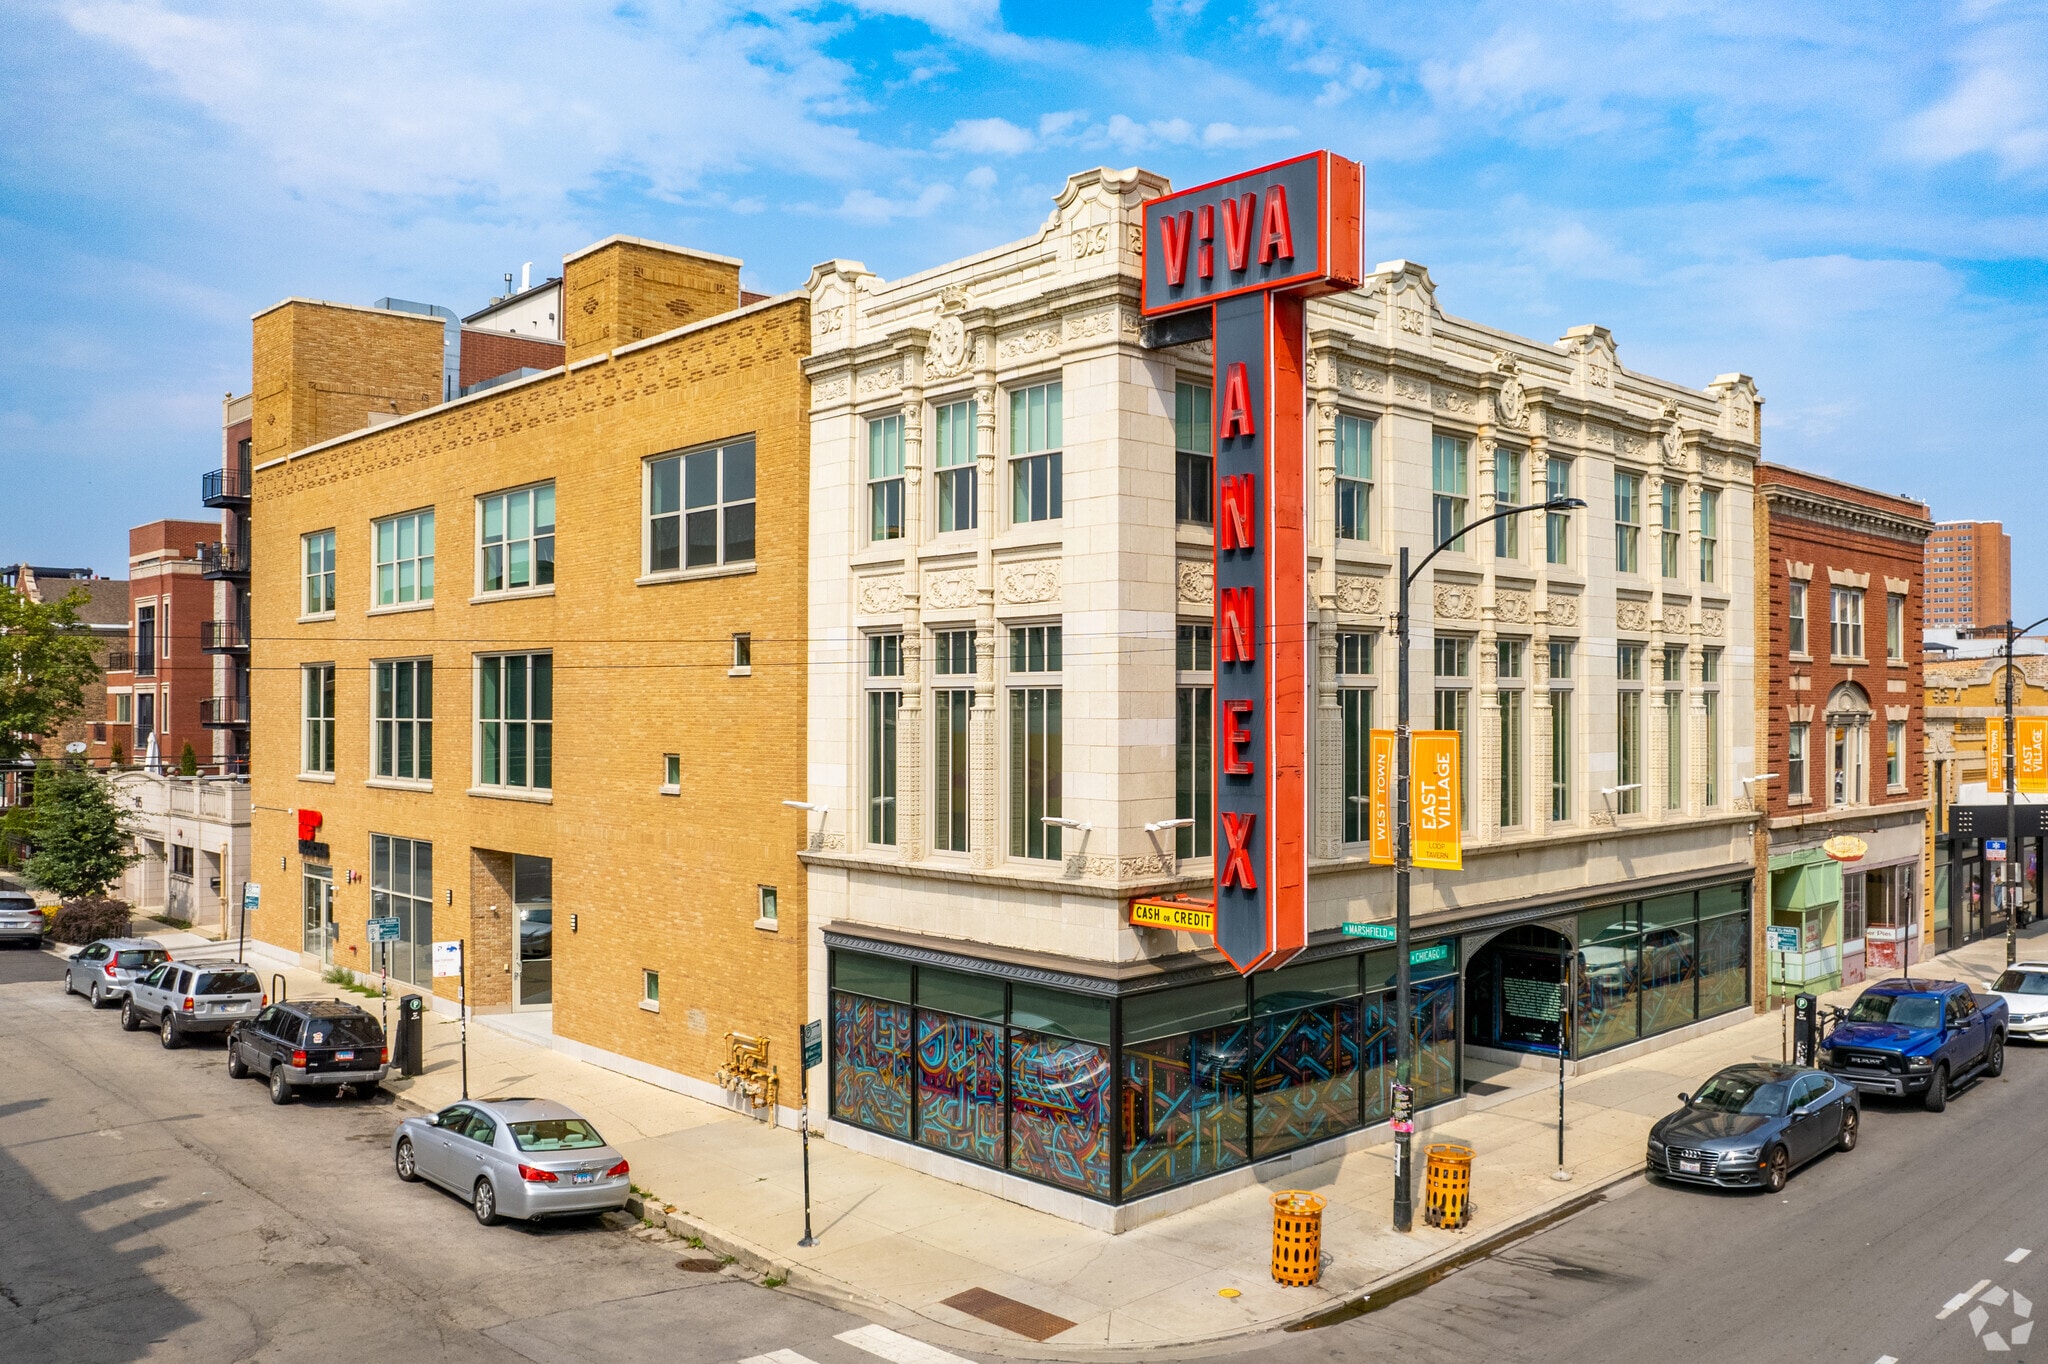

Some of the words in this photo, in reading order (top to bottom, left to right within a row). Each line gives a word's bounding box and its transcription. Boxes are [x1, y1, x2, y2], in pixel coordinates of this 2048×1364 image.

[1219, 361, 1257, 890] ANNEX
[1991, 730, 1999, 754] TOWN
[2032, 729, 2043, 772] VILLAGE
[1377, 753, 1386, 796] TOWN
[1991, 756, 1999, 779] WEST
[1436, 752, 1452, 830] VILLAGE
[1421, 781, 1437, 830] EAST
[1377, 801, 1386, 841] WEST
[1426, 851, 1449, 859] TAVERN
[1428, 842, 1446, 850] LOOP
[1136, 906, 1160, 921] CASH
[1174, 911, 1211, 927] CREDIT
[1349, 924, 1388, 938] MARSHFIELD
[1415, 948, 1440, 963] CHICAGO
